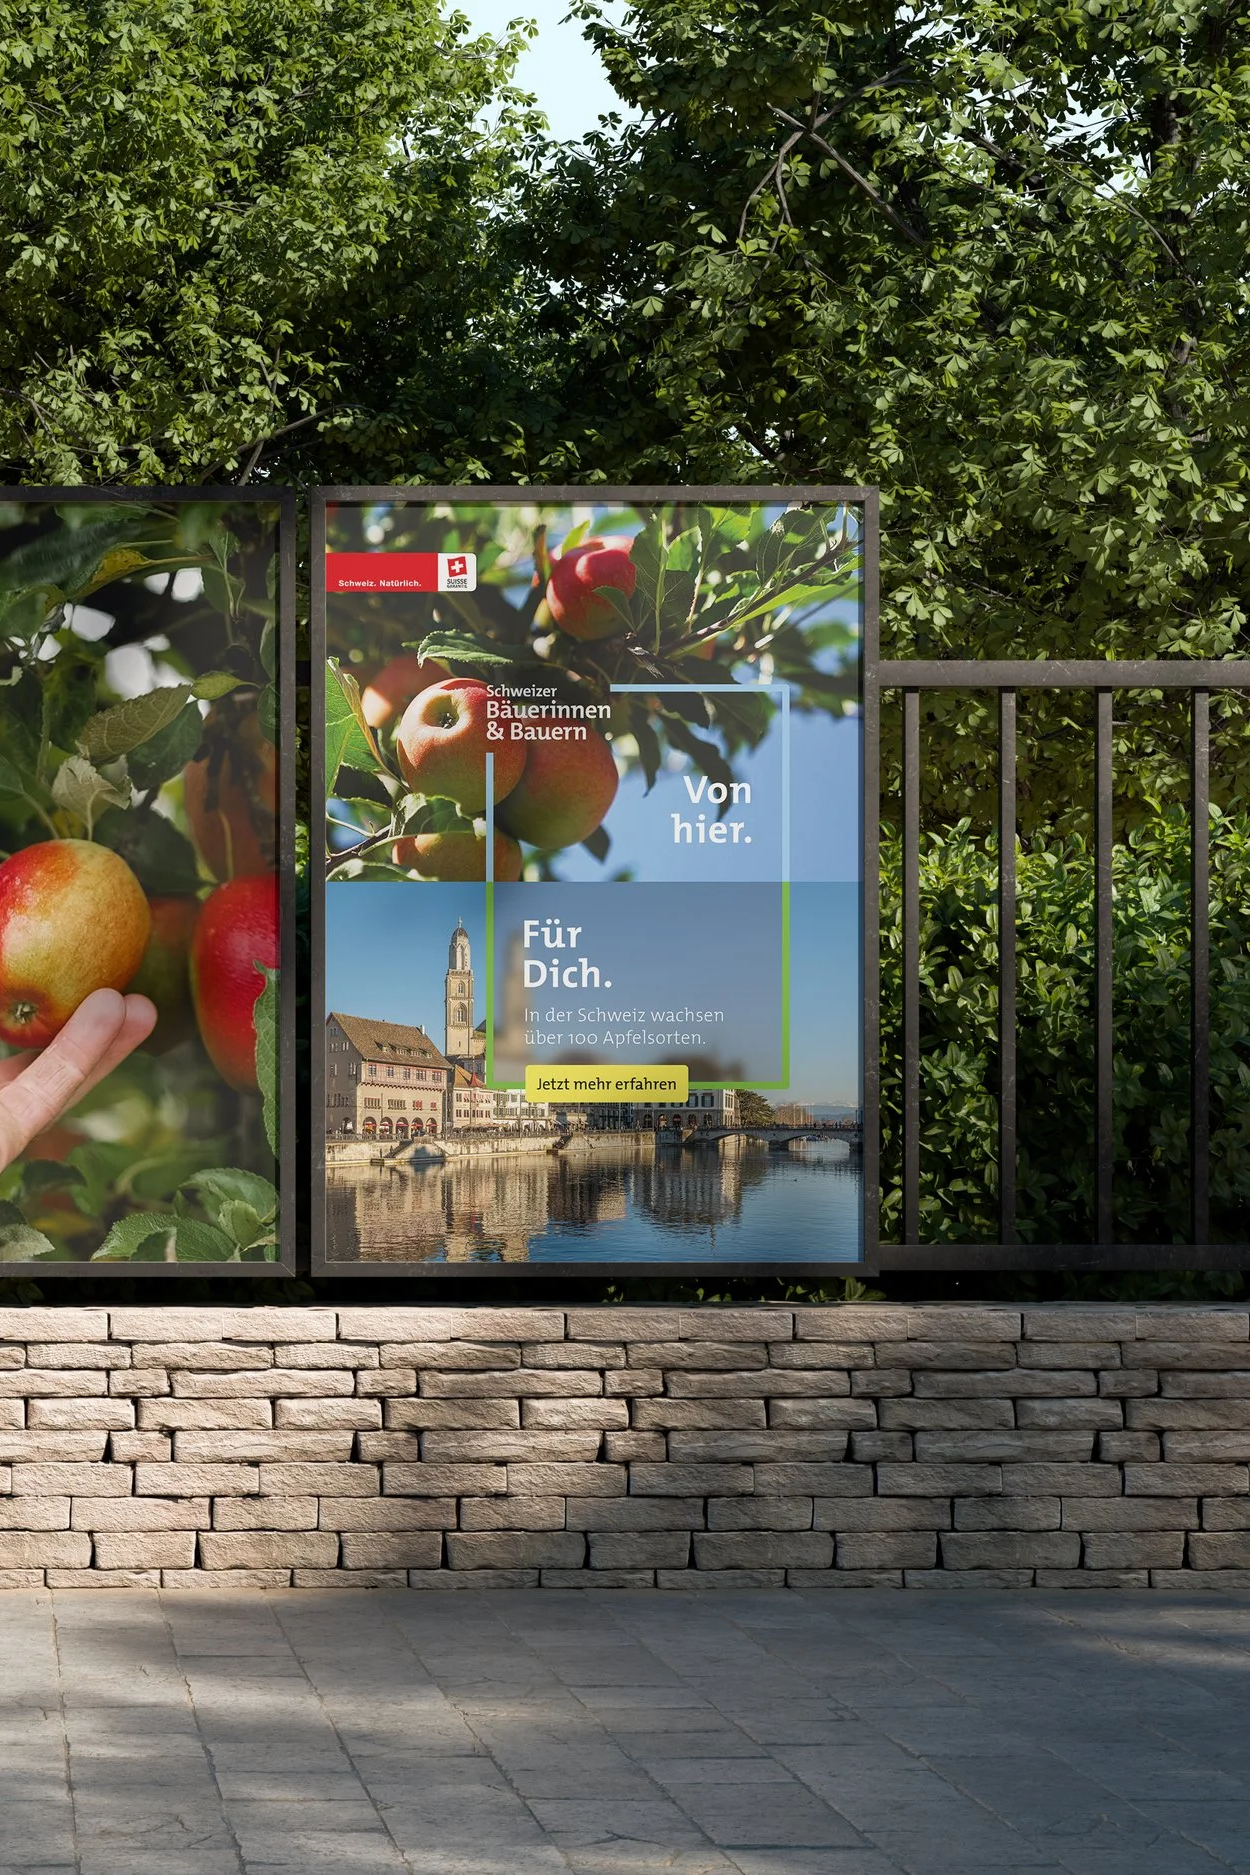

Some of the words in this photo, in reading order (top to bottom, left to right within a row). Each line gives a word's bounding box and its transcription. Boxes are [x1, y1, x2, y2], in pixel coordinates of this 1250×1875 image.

[338, 579, 377, 587] Schweiz.
[379, 579, 422, 587] Natürlich.
[486, 684, 558, 697] Schweizer
[486, 700, 611, 719] Bäuerinnen
[486, 722, 504, 741] &
[510, 722, 587, 741] Bauern
[683, 775, 751, 804] Von
[671, 813, 752, 843] hier.
[523, 918, 582, 948] Für
[523, 957, 613, 988] Dich.
[524, 1008, 540, 1022] In
[545, 1007, 573, 1022] der
[578, 1007, 646, 1022] Schweiz
[650, 1007, 724, 1022] wachsen
[524, 1030, 563, 1045] über
[568, 1033, 598, 1045] 100
[602, 1030, 706, 1049] Apfelsorten.
[536, 1077, 570, 1091] Jetzt
[573, 1076, 611, 1091] mehr
[615, 1076, 677, 1091] erfahren
